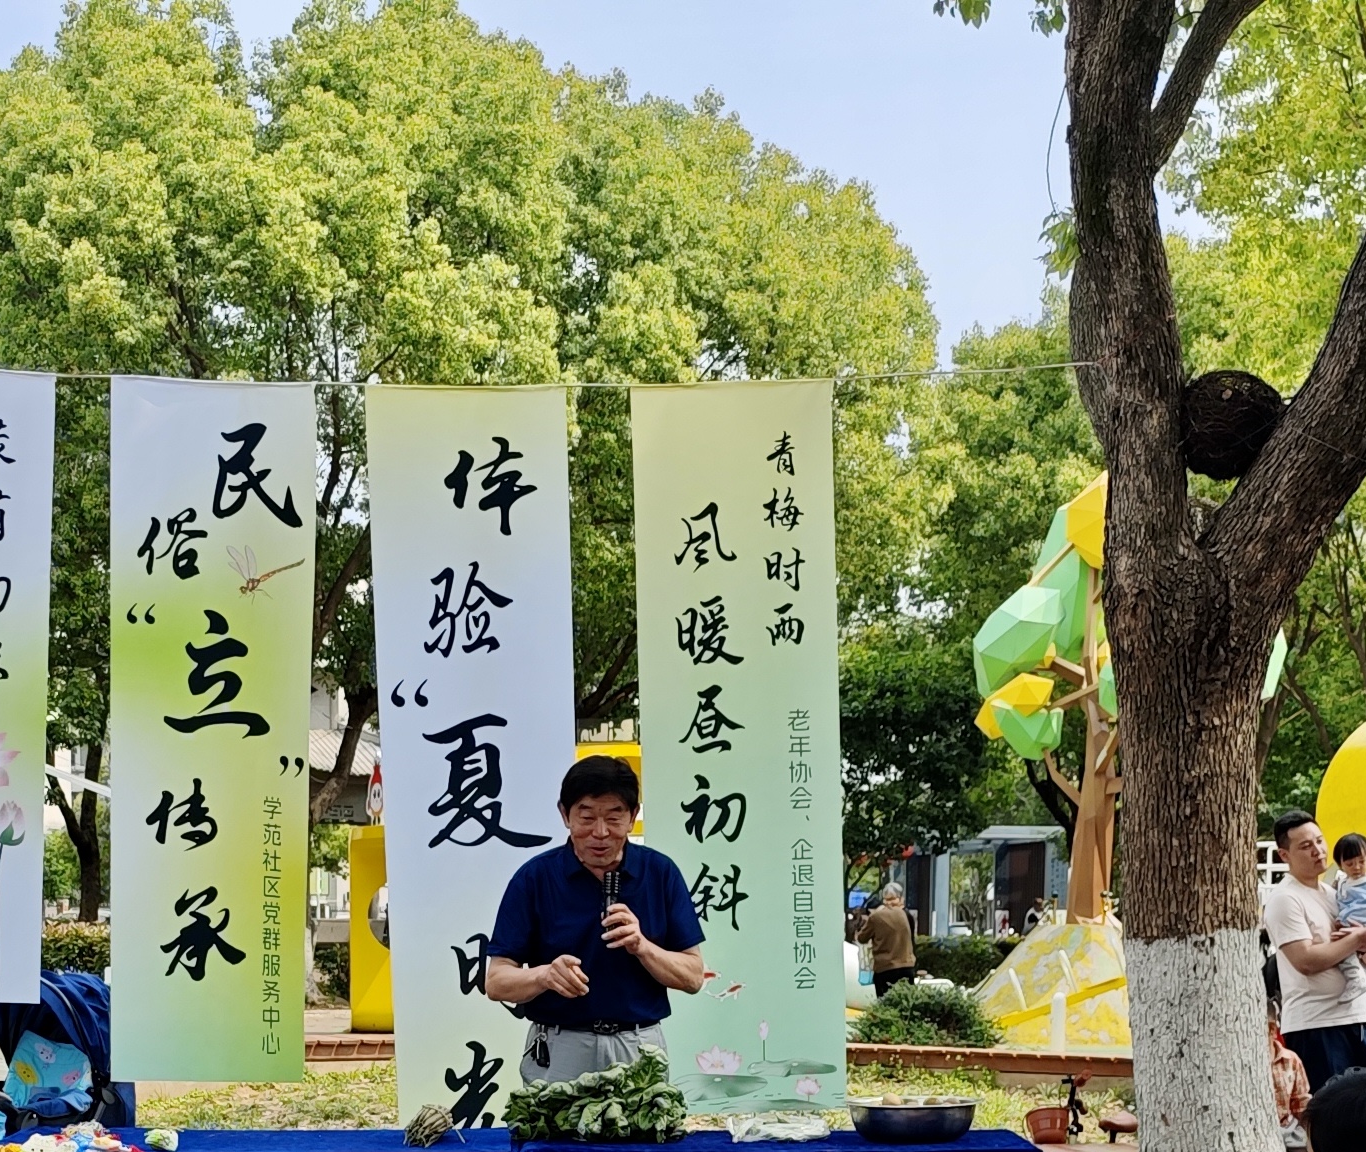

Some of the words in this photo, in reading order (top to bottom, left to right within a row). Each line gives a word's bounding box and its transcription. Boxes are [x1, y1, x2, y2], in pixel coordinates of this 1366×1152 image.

[262, 796, 282, 1055] 学苑社区党群服务中心
